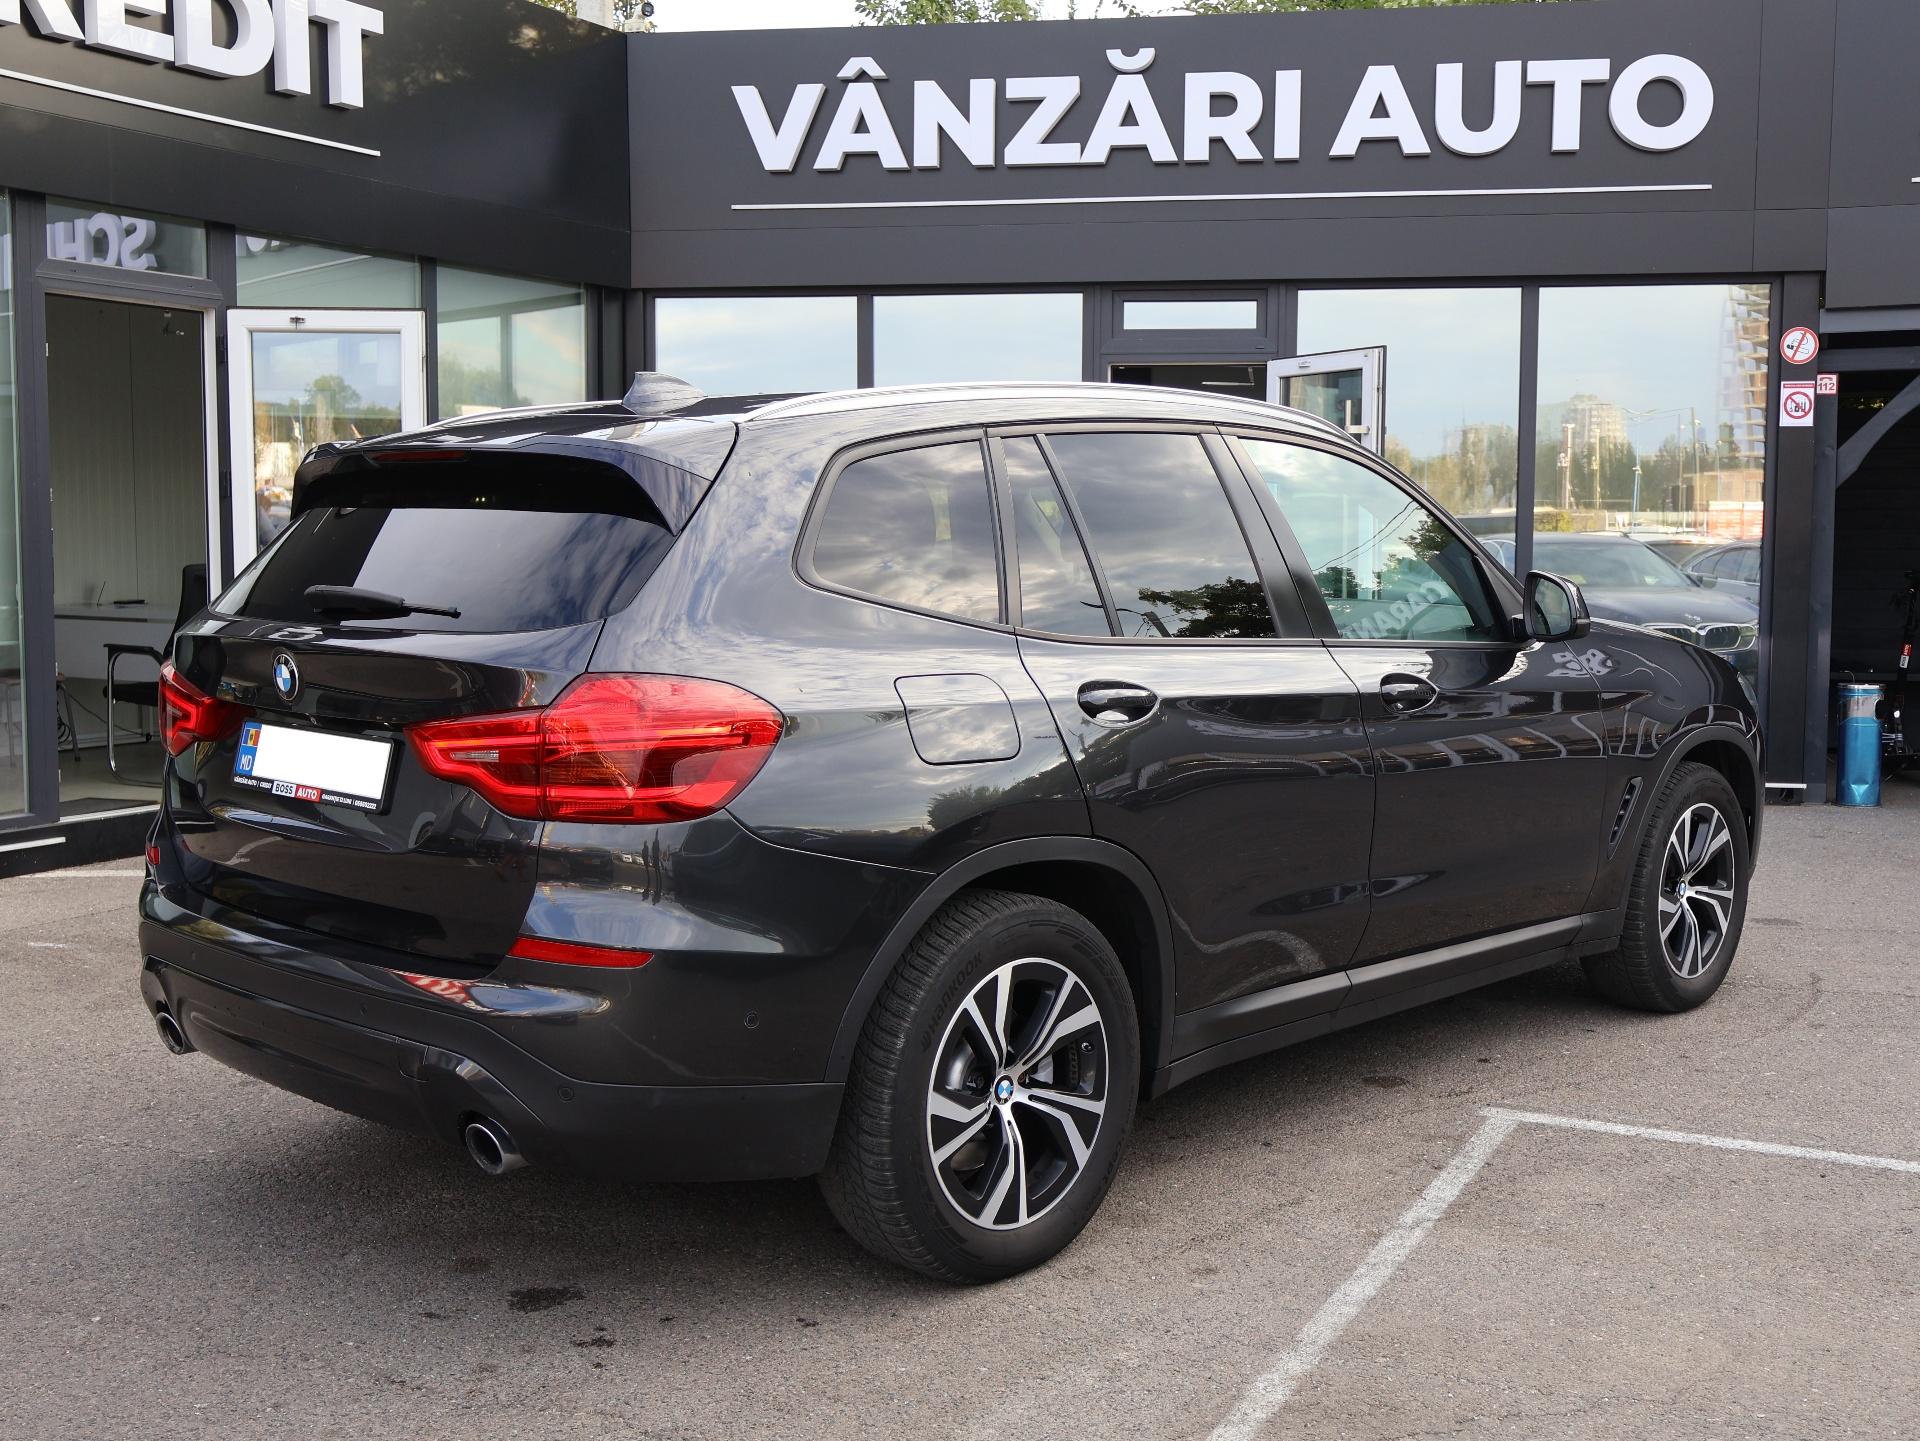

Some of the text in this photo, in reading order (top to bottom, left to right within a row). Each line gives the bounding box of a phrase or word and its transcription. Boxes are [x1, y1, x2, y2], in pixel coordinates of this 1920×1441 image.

[731, 47, 1714, 172] VÂNZĂRI AUTO
[1817, 382, 1836, 391] 112
[240, 754, 252, 771] MD
[275, 783, 293, 795] BOSS
[296, 788, 318, 800] AUTO
